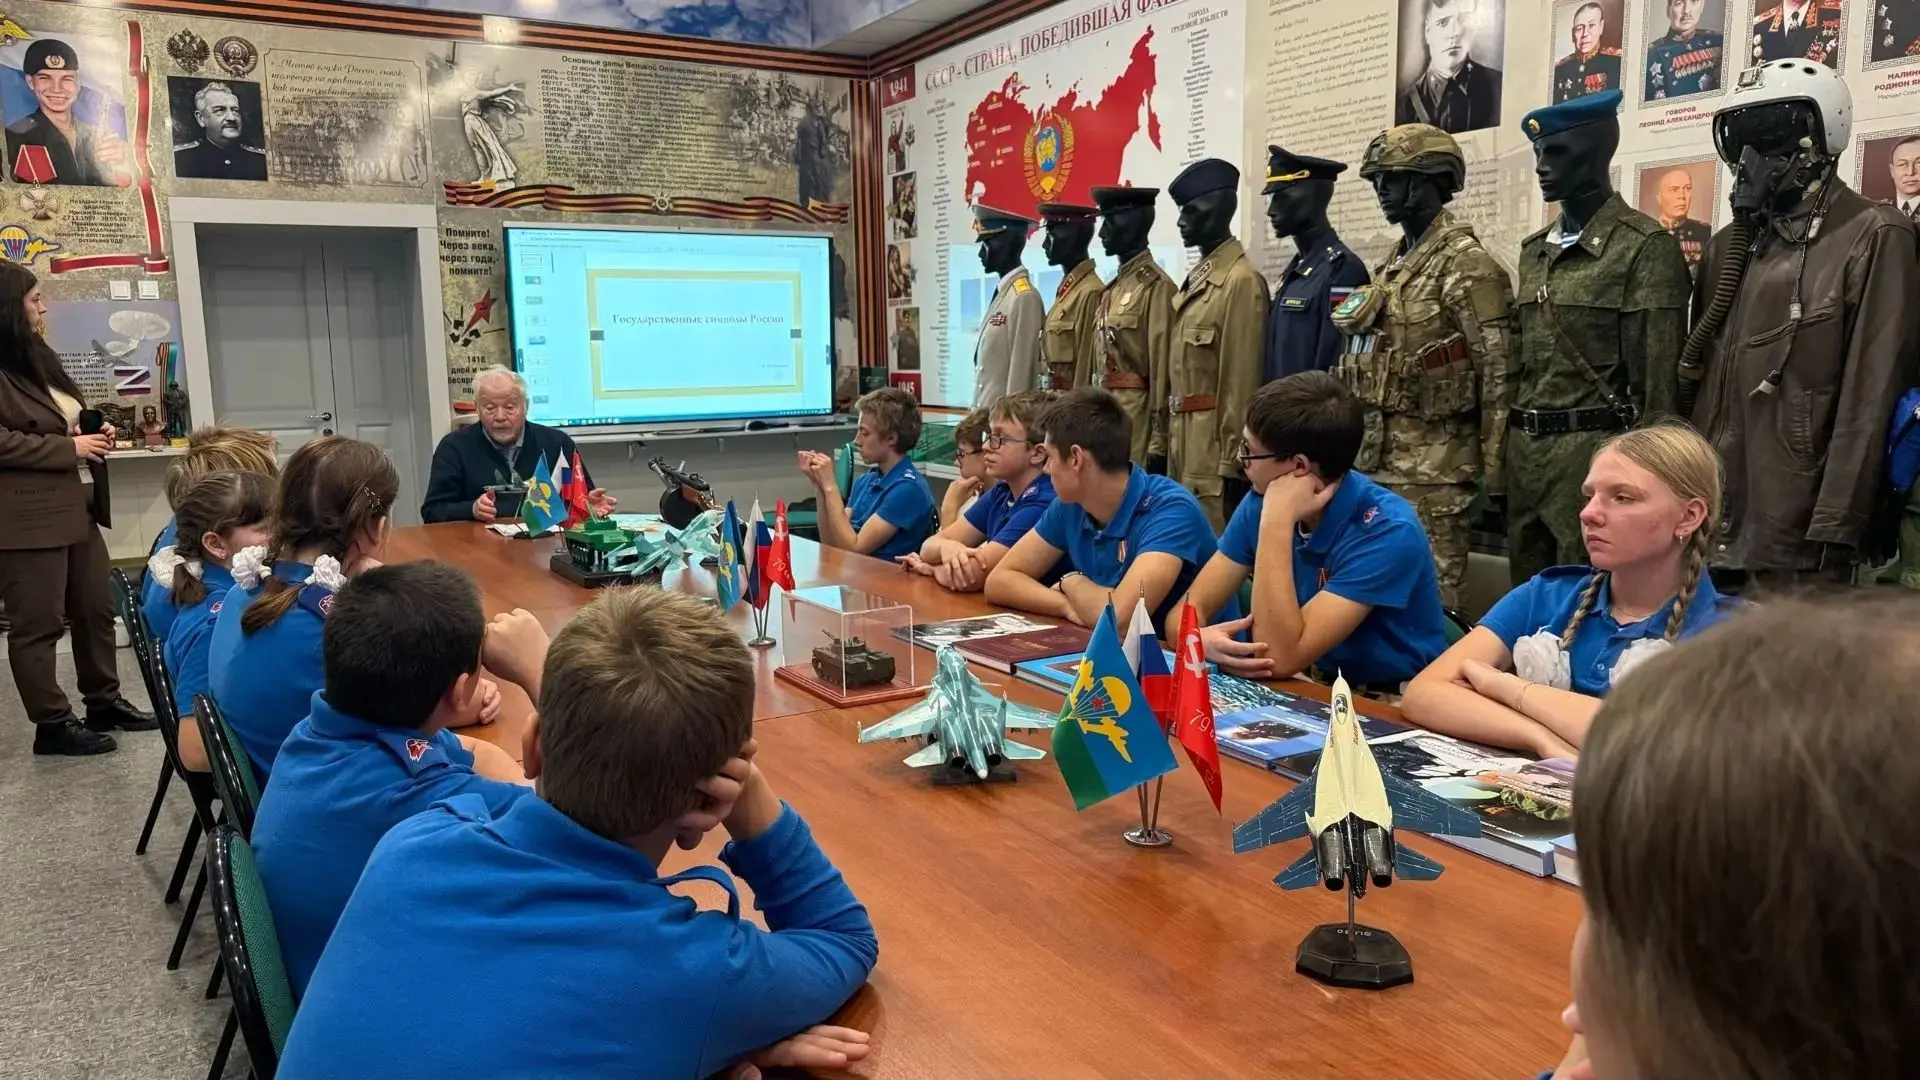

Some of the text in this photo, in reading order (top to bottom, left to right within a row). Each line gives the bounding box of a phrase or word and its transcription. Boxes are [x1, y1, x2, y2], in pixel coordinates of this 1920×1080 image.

[926, 66, 955, 90] СССР
[964, 42, 1017, 76] СТРАНА,
[1020, 1, 1131, 57] ПОБЕДИВШАЯ
[562, 55, 600, 66] Основные
[626, 61, 658, 72] Великой
[1874, 81, 1910, 91] РОДИОН
[1666, 106, 1696, 116] ГОВОРОВ
[1639, 112, 1718, 128] ЛЕОНИД АЛЕКСАНДРОВ
[446, 228, 490, 238] Помните!
[440, 240, 498, 252] Через века,
[440, 255, 468, 264] через
[448, 266, 492, 276] помните!
[613, 314, 784, 326] Государственные символы России
[451, 366, 470, 374] дней
[1189, 708, 1210, 732] 79
